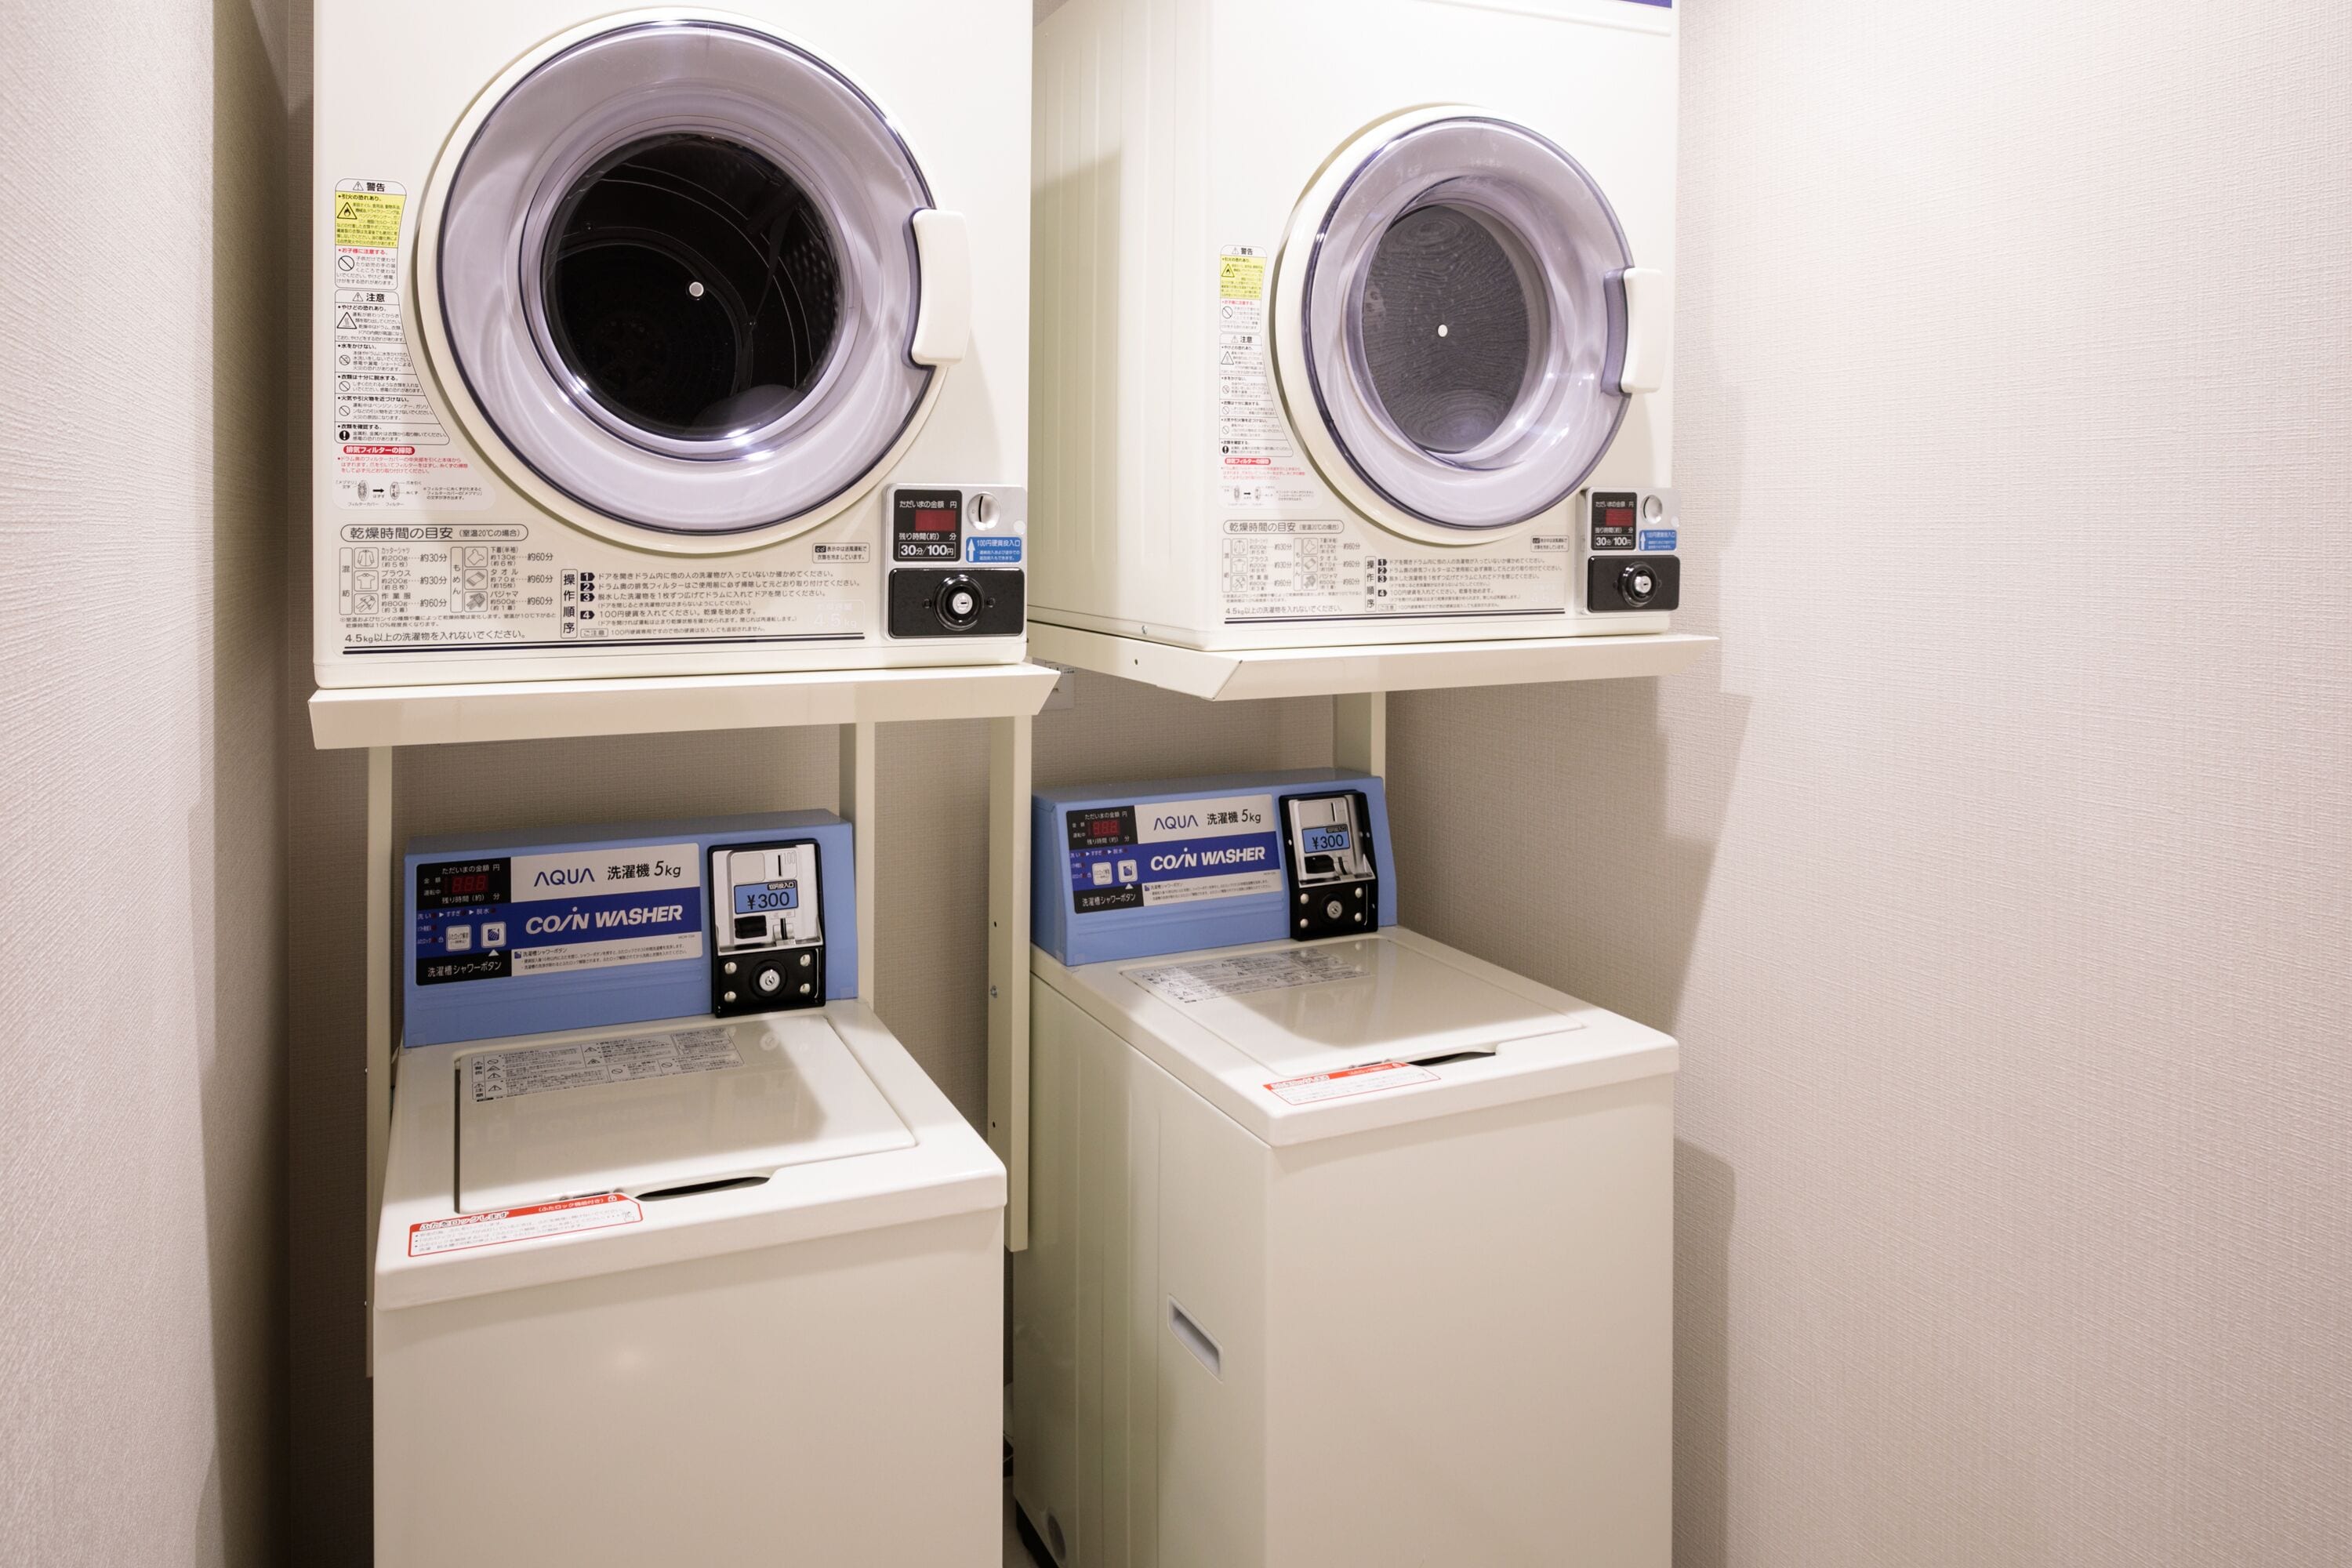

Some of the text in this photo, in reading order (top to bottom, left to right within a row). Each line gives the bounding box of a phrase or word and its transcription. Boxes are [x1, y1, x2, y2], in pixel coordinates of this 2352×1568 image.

[366, 182, 386, 192] 警告
[1240, 247, 1254, 256] 警告
[366, 292, 385, 303] 注意
[1229, 522, 1296, 532] 乾燥時間の目安
[350, 527, 453, 539] 乾燥時間の目安
[901, 545, 953, 556] 30分/100円
[420, 554, 447, 562] 約30分
[527, 553, 554, 561] 約60分
[420, 575, 447, 585] 約30分
[527, 575, 554, 583] 約60分
[420, 599, 447, 608] 約60分
[527, 597, 554, 605] 約60分
[563, 573, 575, 634] 操作順序
[600, 608, 757, 619] 100円硬貨を入れてください。乾燥を始めます。
[345, 630, 526, 644] 4.5kg以上の洗濯物を入れないでください。
[1207, 811, 1239, 825] 洗濯機
[1241, 808, 1261, 825] 5kg
[1312, 834, 1343, 849] ¥300
[1202, 846, 1265, 866] WASHER
[442, 864, 489, 875] ただいまの金額
[607, 864, 650, 880] 洗濯機
[654, 860, 681, 878] 5kg
[441, 895, 485, 904] 残り時間（約）
[747, 891, 789, 909] ¥300
[1082, 894, 1136, 907] 洗濯槽シャワーボタン
[596, 905, 683, 927] WASHER
[427, 961, 502, 978] 洗濯槽シャワーボタン
[419, 1211, 509, 1230] ふたをロックします
